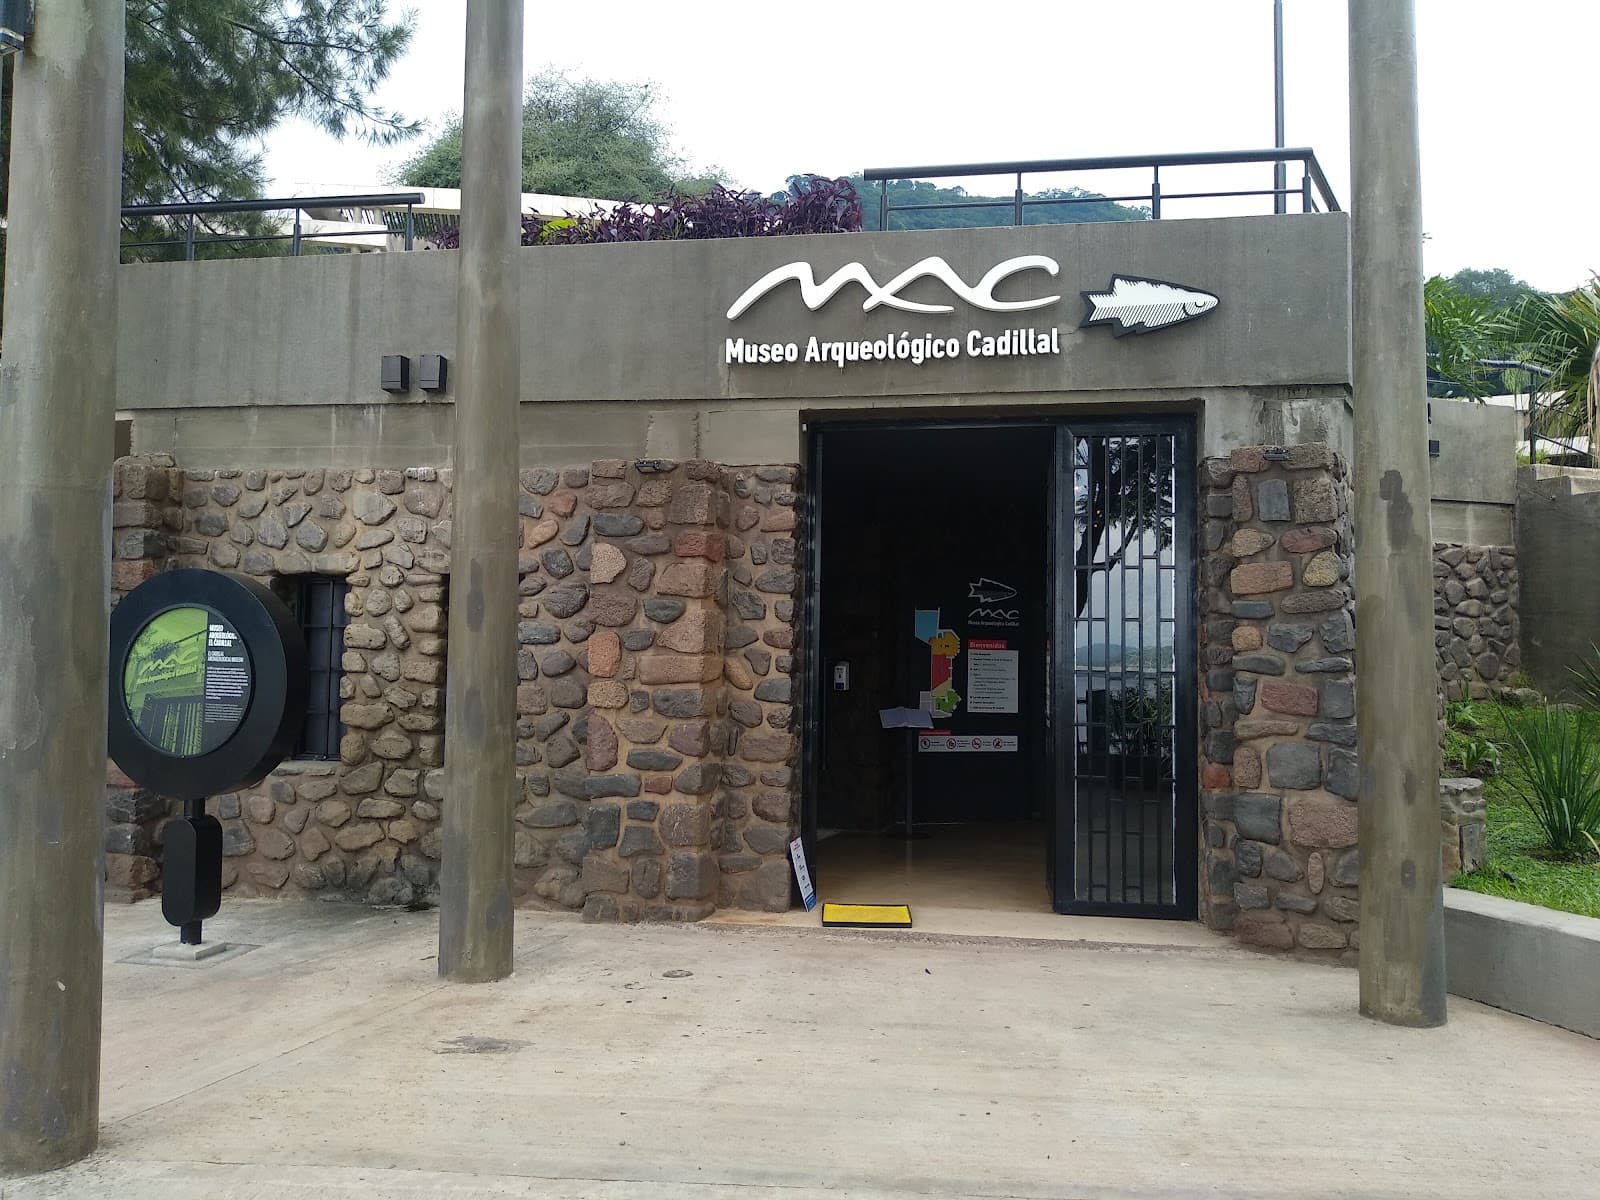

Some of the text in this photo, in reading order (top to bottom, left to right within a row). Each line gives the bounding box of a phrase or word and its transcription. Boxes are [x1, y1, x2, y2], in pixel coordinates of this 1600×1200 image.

[725, 327, 1060, 368] Museo Arqueológico Cadillal
